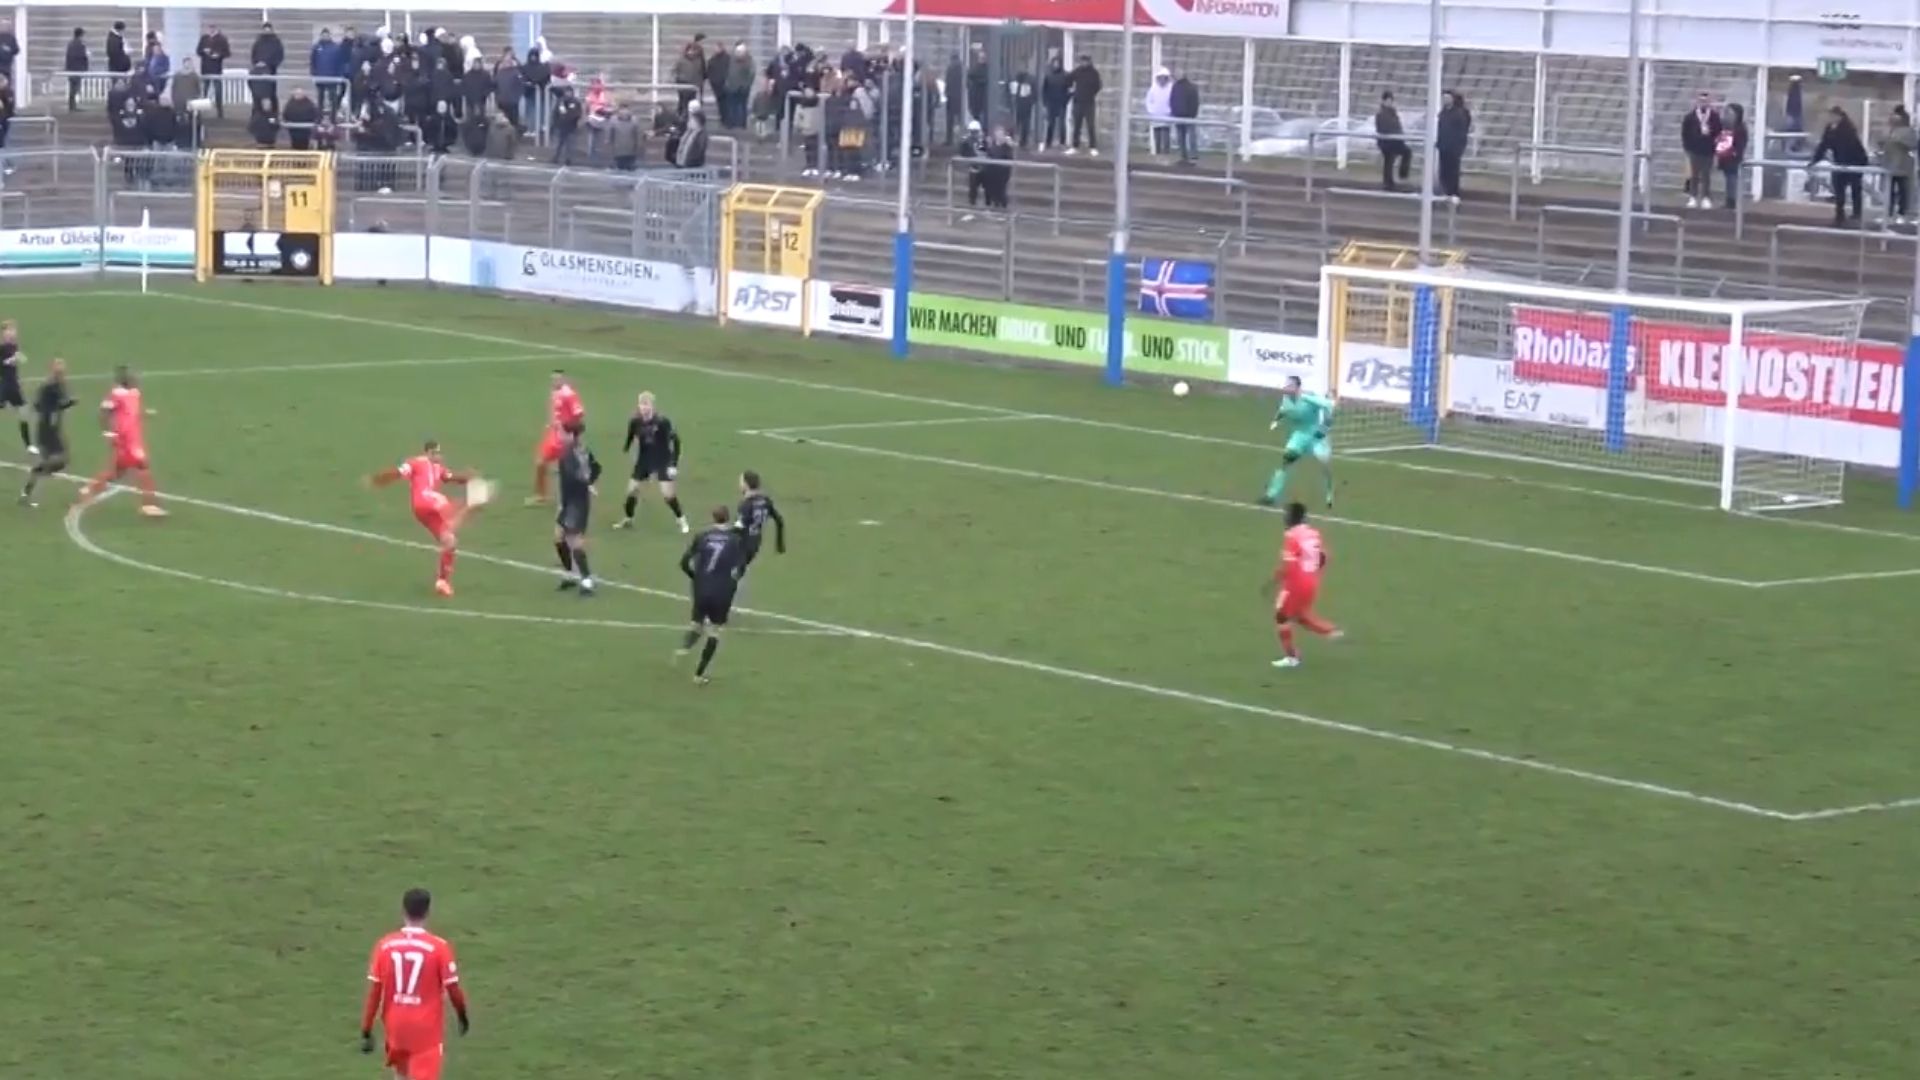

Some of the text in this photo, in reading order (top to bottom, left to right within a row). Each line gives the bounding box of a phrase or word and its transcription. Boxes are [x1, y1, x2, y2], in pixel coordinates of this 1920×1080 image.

[290, 191, 308, 207] 11
[19, 233, 55, 246] Artur
[784, 233, 798, 250] 12
[909, 307, 936, 331] WIR
[939, 309, 997, 338] MACHEN
[1055, 325, 1086, 348] UND
[1142, 334, 1174, 360] UND
[1256, 349, 1314, 366] spessart
[1504, 390, 1541, 412] EA7
[706, 541, 725, 573] 7
[391, 951, 424, 994] 17
